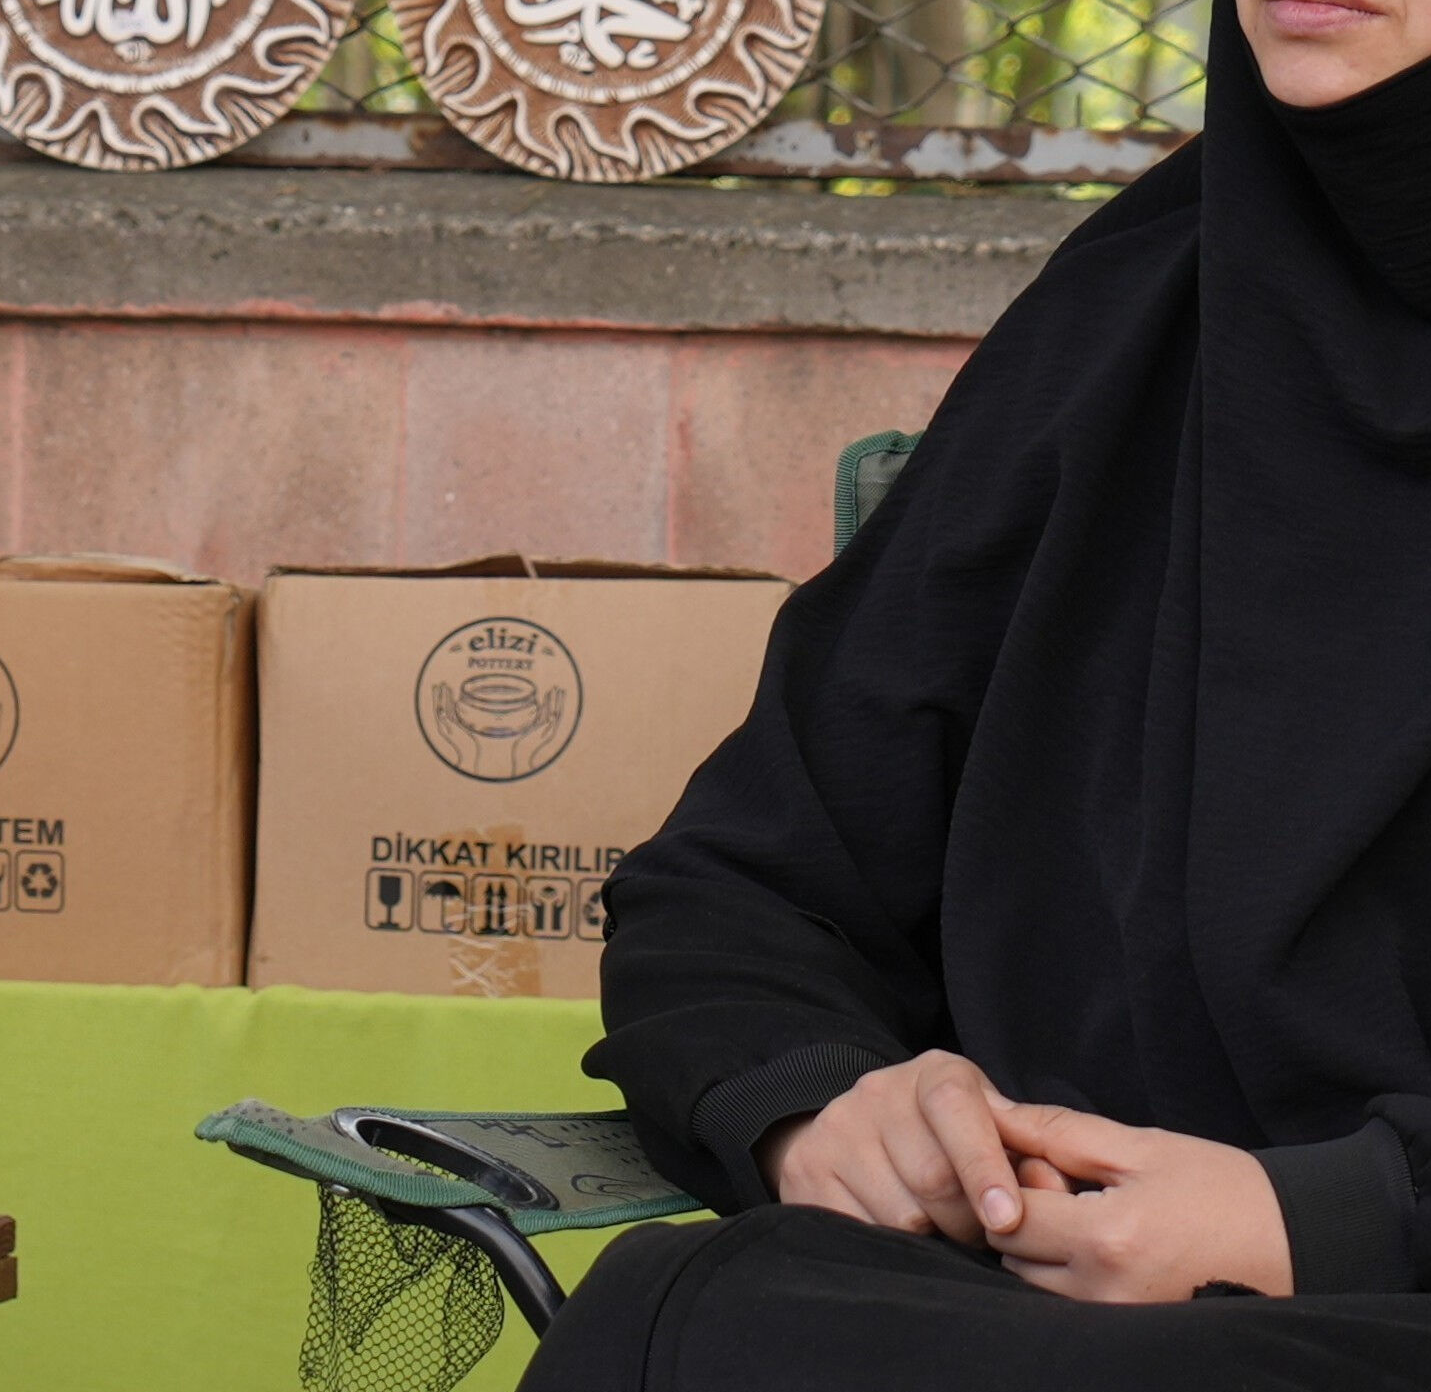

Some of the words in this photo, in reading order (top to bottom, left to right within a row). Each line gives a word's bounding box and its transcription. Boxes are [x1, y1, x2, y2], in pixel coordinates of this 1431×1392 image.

[468, 627, 539, 655] elizi
[468, 656, 535, 671] POTTERY
[371, 832, 494, 867] DİKKAT
